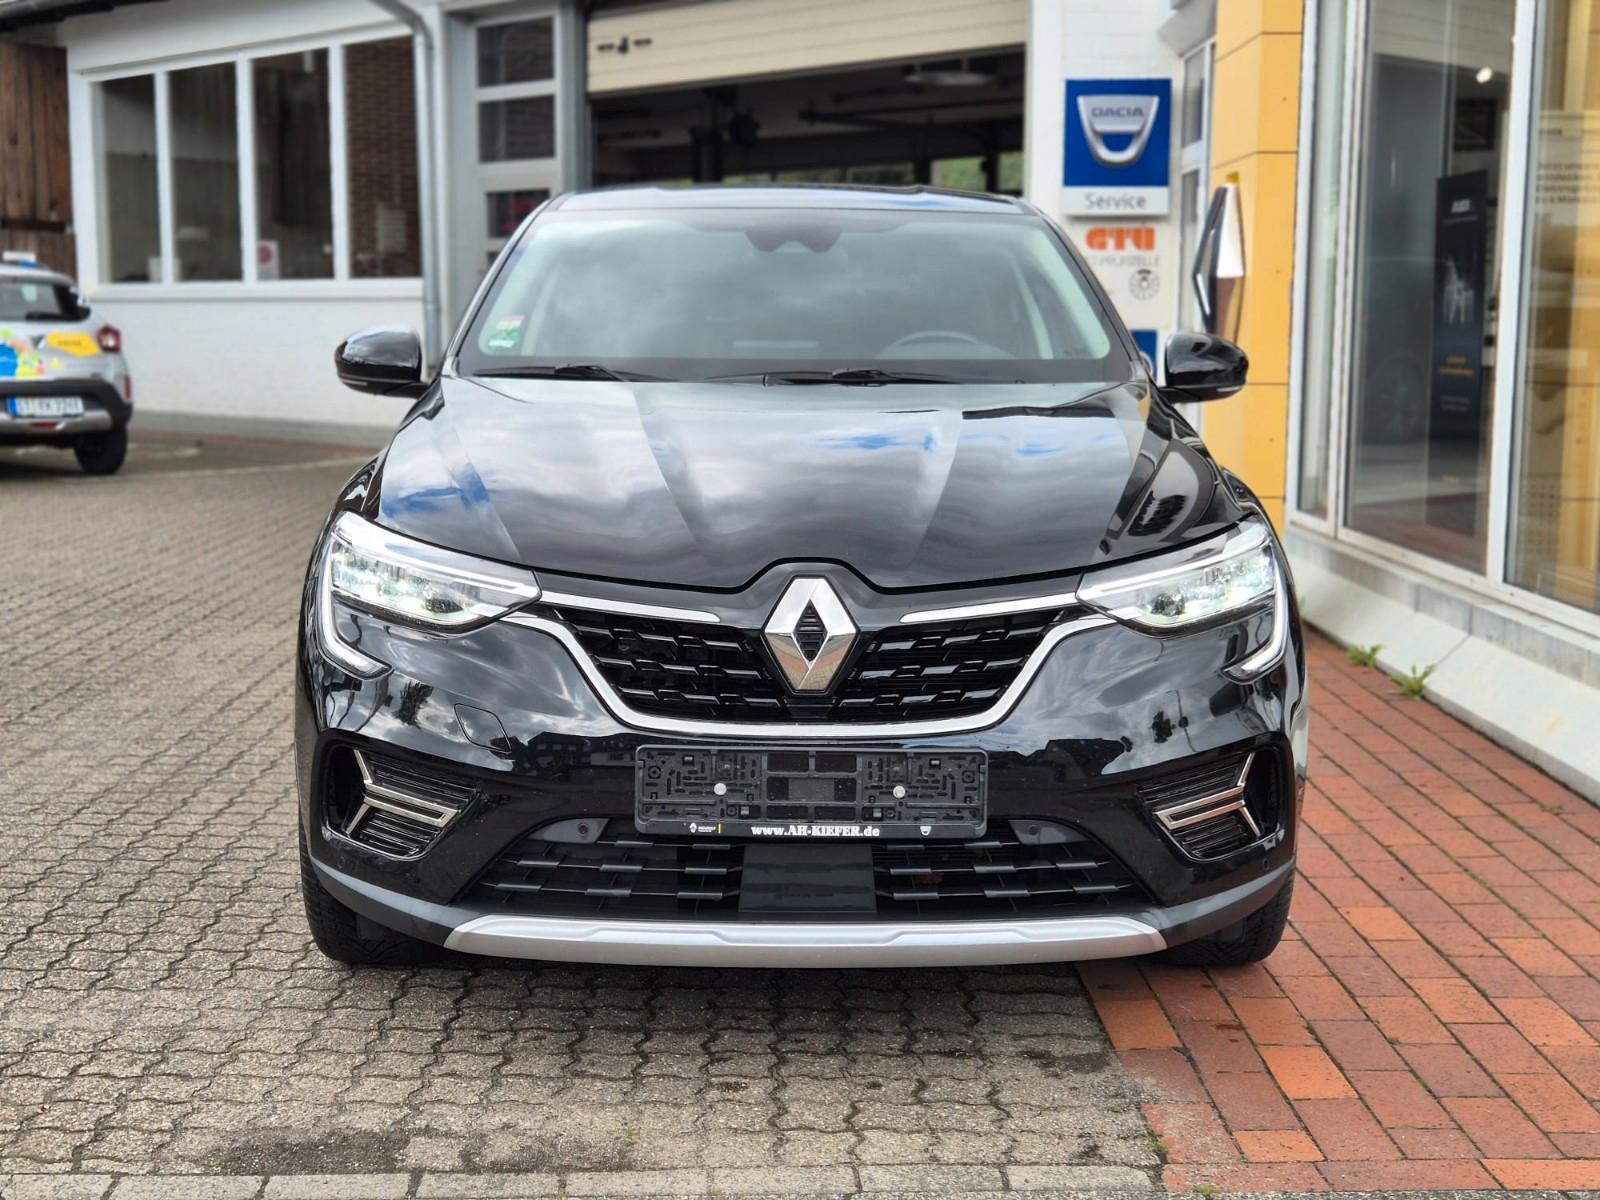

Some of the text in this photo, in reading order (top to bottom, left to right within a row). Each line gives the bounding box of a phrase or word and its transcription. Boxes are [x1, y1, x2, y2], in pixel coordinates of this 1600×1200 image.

[1091, 106, 1144, 118] DACIA
[1085, 193, 1147, 209] Service
[750, 825, 881, 837] www.AH-KIEFER.de
